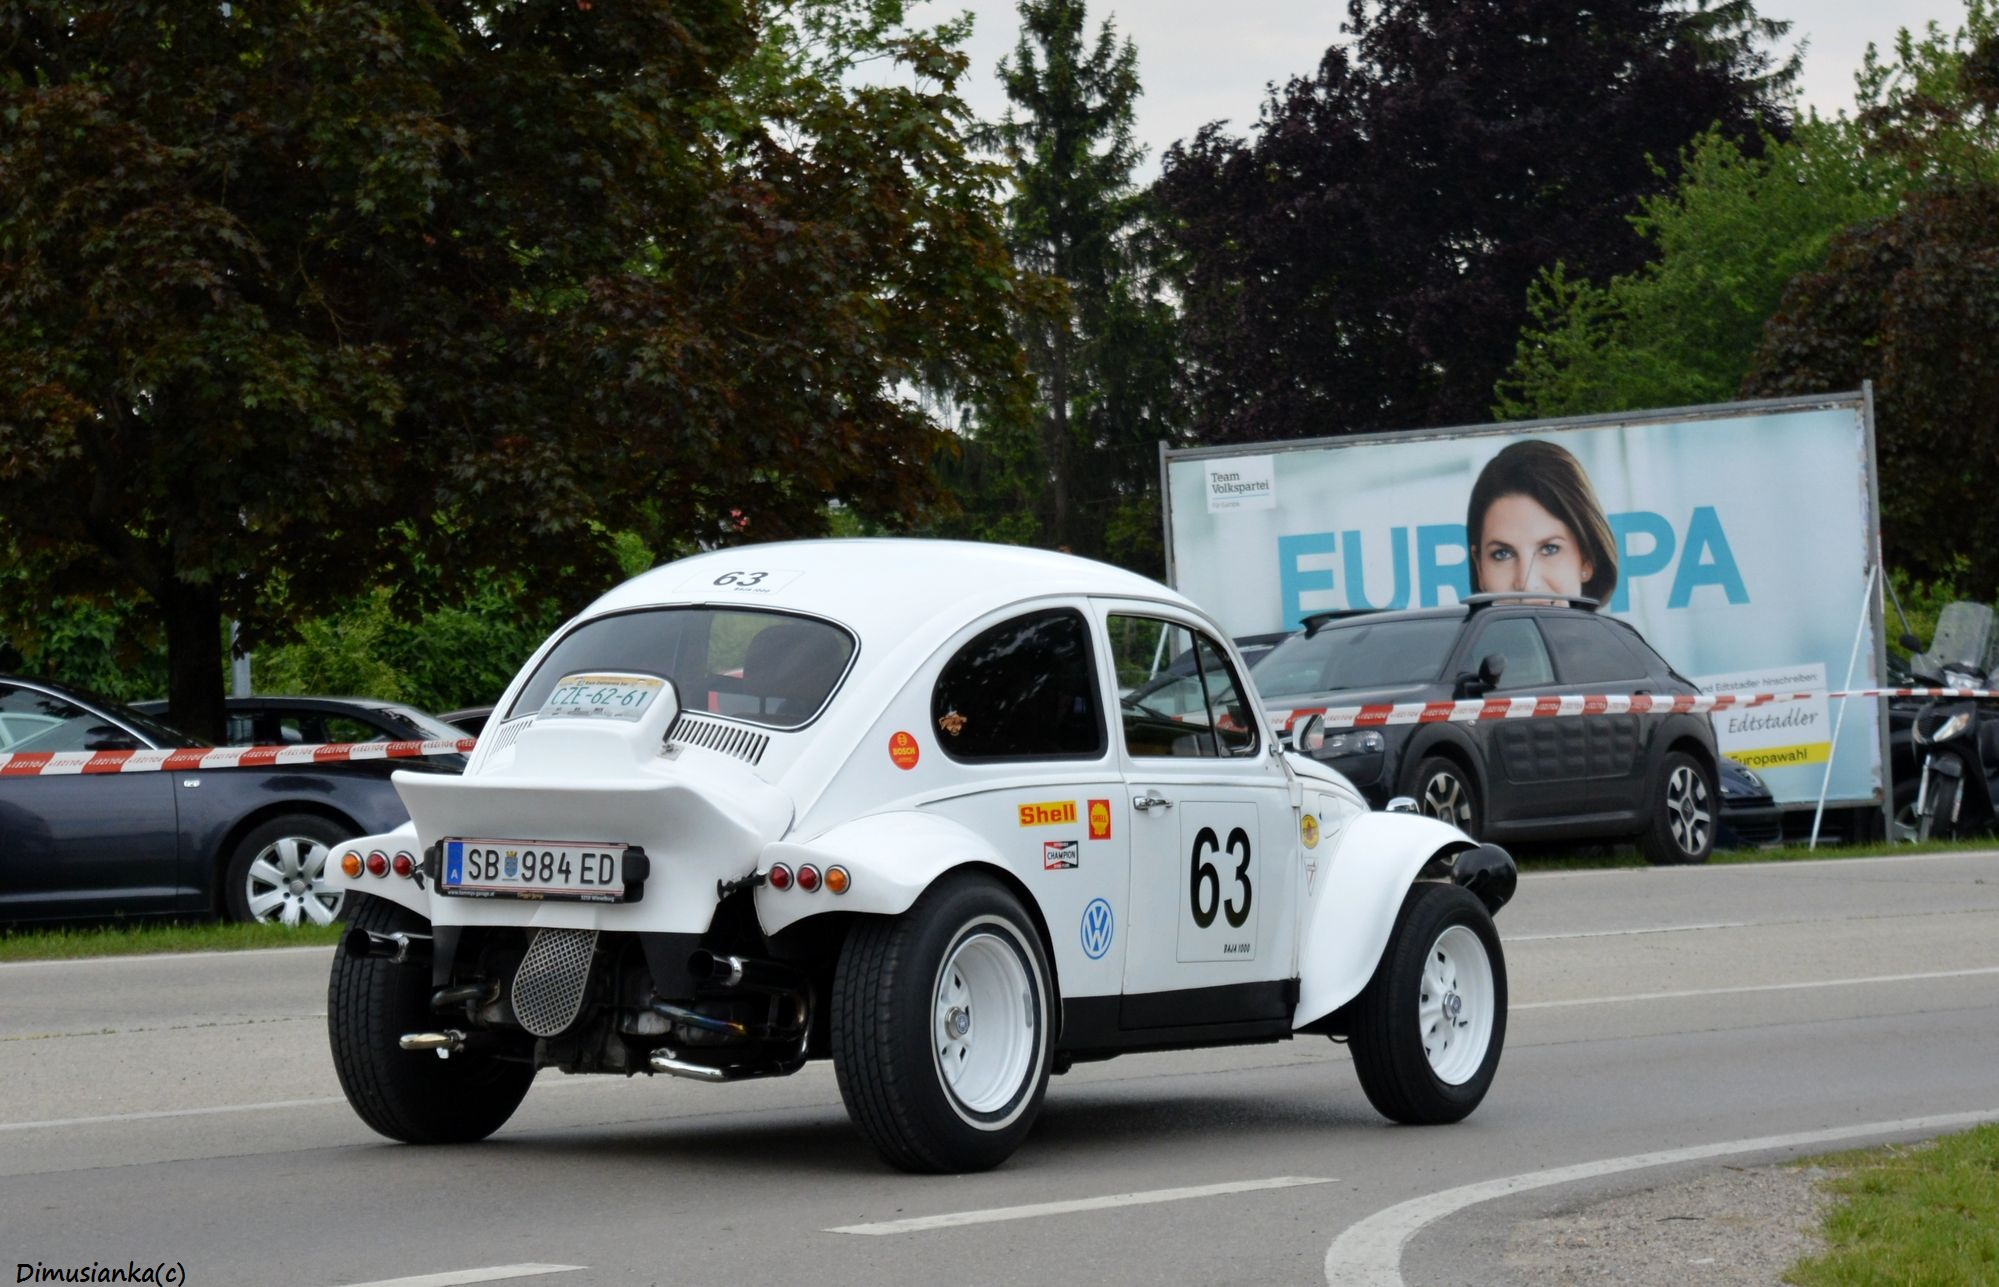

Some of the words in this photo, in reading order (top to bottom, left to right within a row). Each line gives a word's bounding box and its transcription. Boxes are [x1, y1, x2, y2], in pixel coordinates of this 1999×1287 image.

[1210, 473, 1240, 482] Team
[1212, 480, 1269, 494] Volkspartei
[1278, 506, 1750, 631] EURPA
[713, 571, 769, 586] 63
[1716, 680, 1760, 691] Edtstadler
[551, 687, 648, 707] CZE-62-61
[1728, 708, 1819, 734] Edtstadler
[893, 747, 915, 755] BOSCH
[1020, 803, 1075, 825] Shell
[1092, 814, 1107, 823] SHELL
[1047, 851, 1075, 860] CHAMPION
[450, 869, 459, 880] A
[468, 849, 500, 881] SB
[521, 851, 572, 884] 984
[580, 853, 615, 885] ED
[1190, 827, 1252, 929] 63
